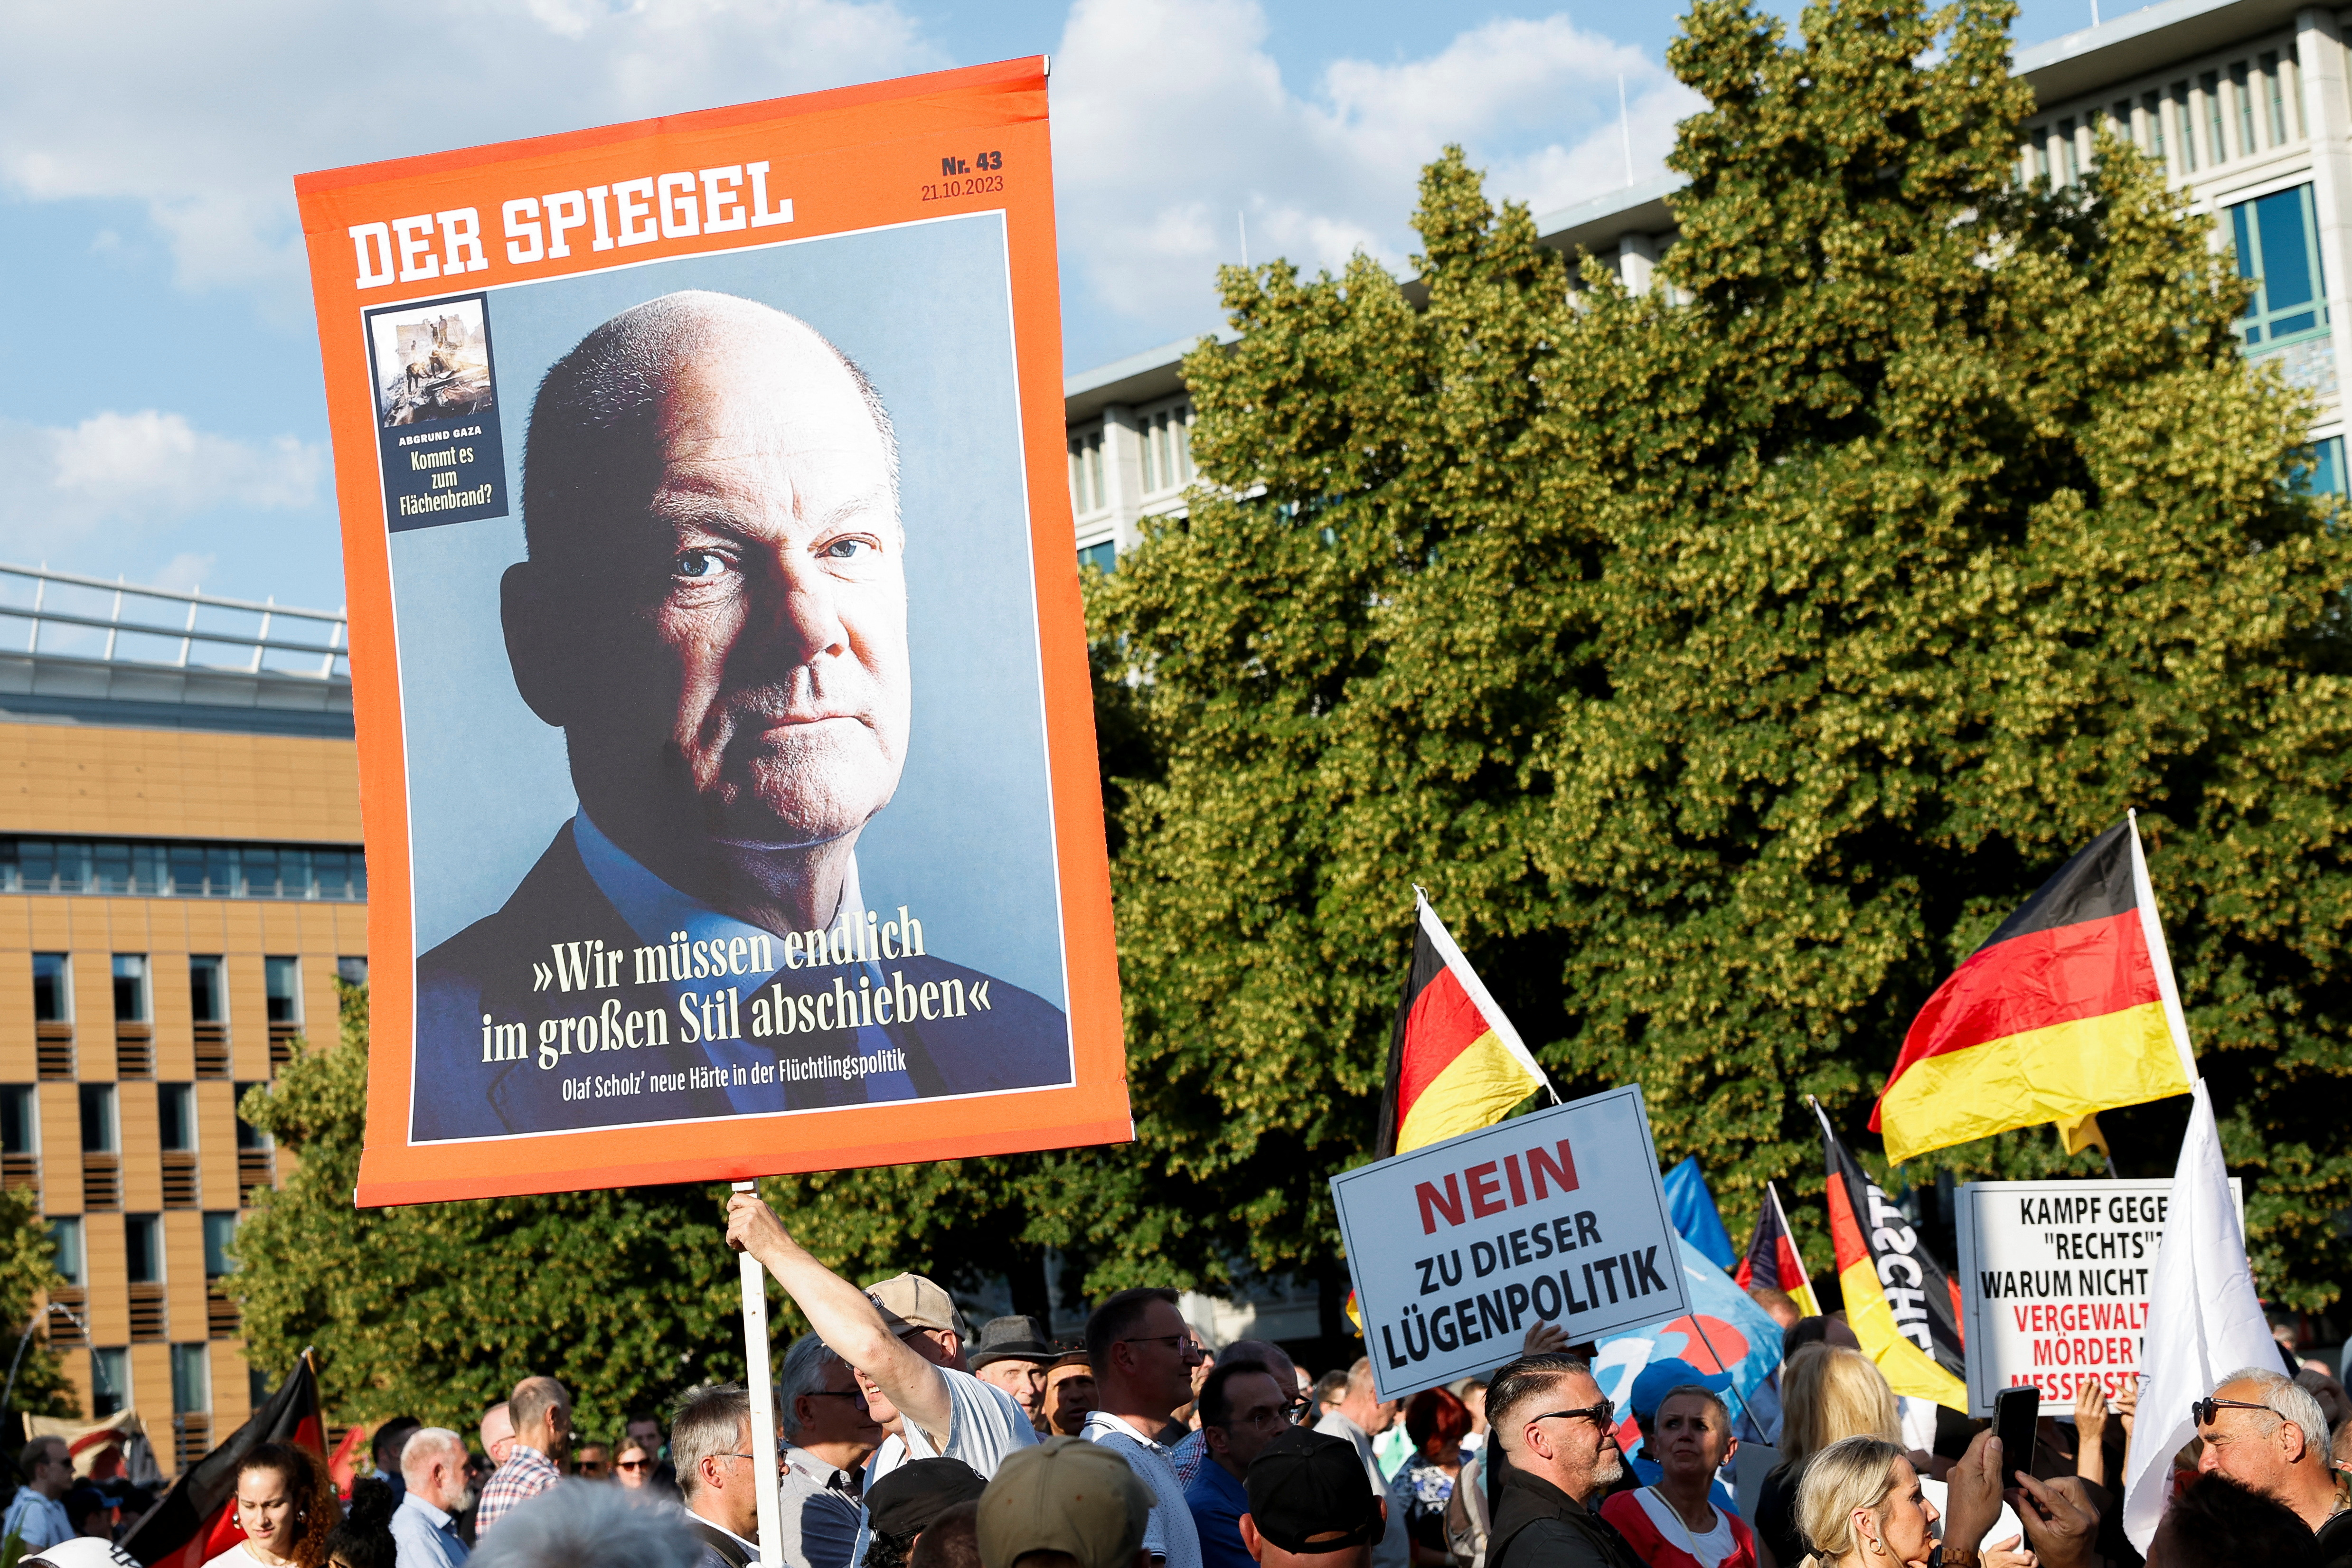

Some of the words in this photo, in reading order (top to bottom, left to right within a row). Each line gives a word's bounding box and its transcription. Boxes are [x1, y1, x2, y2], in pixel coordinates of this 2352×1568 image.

[941, 156, 970, 177] Nr.
[976, 150, 1003, 171] 43
[921, 175, 1004, 201] 21.10.2023
[348, 207, 489, 289] DER
[502, 160, 794, 264] SPIEGEL
[398, 430, 450, 447] ABGRUND
[452, 425, 482, 438] GAZA
[410, 446, 457, 471] Kommt
[459, 447, 474, 464] es
[431, 471, 458, 490] zum
[399, 483, 493, 516] Flächenbrand?
[533, 939, 624, 992] »Wir
[633, 930, 774, 985] müssen
[784, 904, 926, 970] endlich
[481, 1014, 529, 1063] im
[538, 998, 670, 1070] großen
[678, 986, 742, 1043] Stil
[751, 970, 992, 1038] abschieben«
[562, 1076, 592, 1101] Olaf
[650, 1072, 685, 1093] neue
[689, 1066, 729, 1089] Härte
[733, 1063, 747, 1086] in
[751, 1061, 775, 1085] der
[779, 1048, 907, 1082] Flüchtlingspolitik
[1414, 1138, 1581, 1235] NEIN
[2020, 1197, 2101, 1225] KAMPF
[1415, 1249, 1463, 1296] ZU
[1470, 1210, 1603, 1278] DIESER
[1981, 1270, 2072, 1299] WARUM
[2079, 1269, 2148, 1296] NICHT
[1382, 1245, 1668, 1371] LÜGENPOLITIK
[2033, 1332, 2133, 1366] MÖRDER
